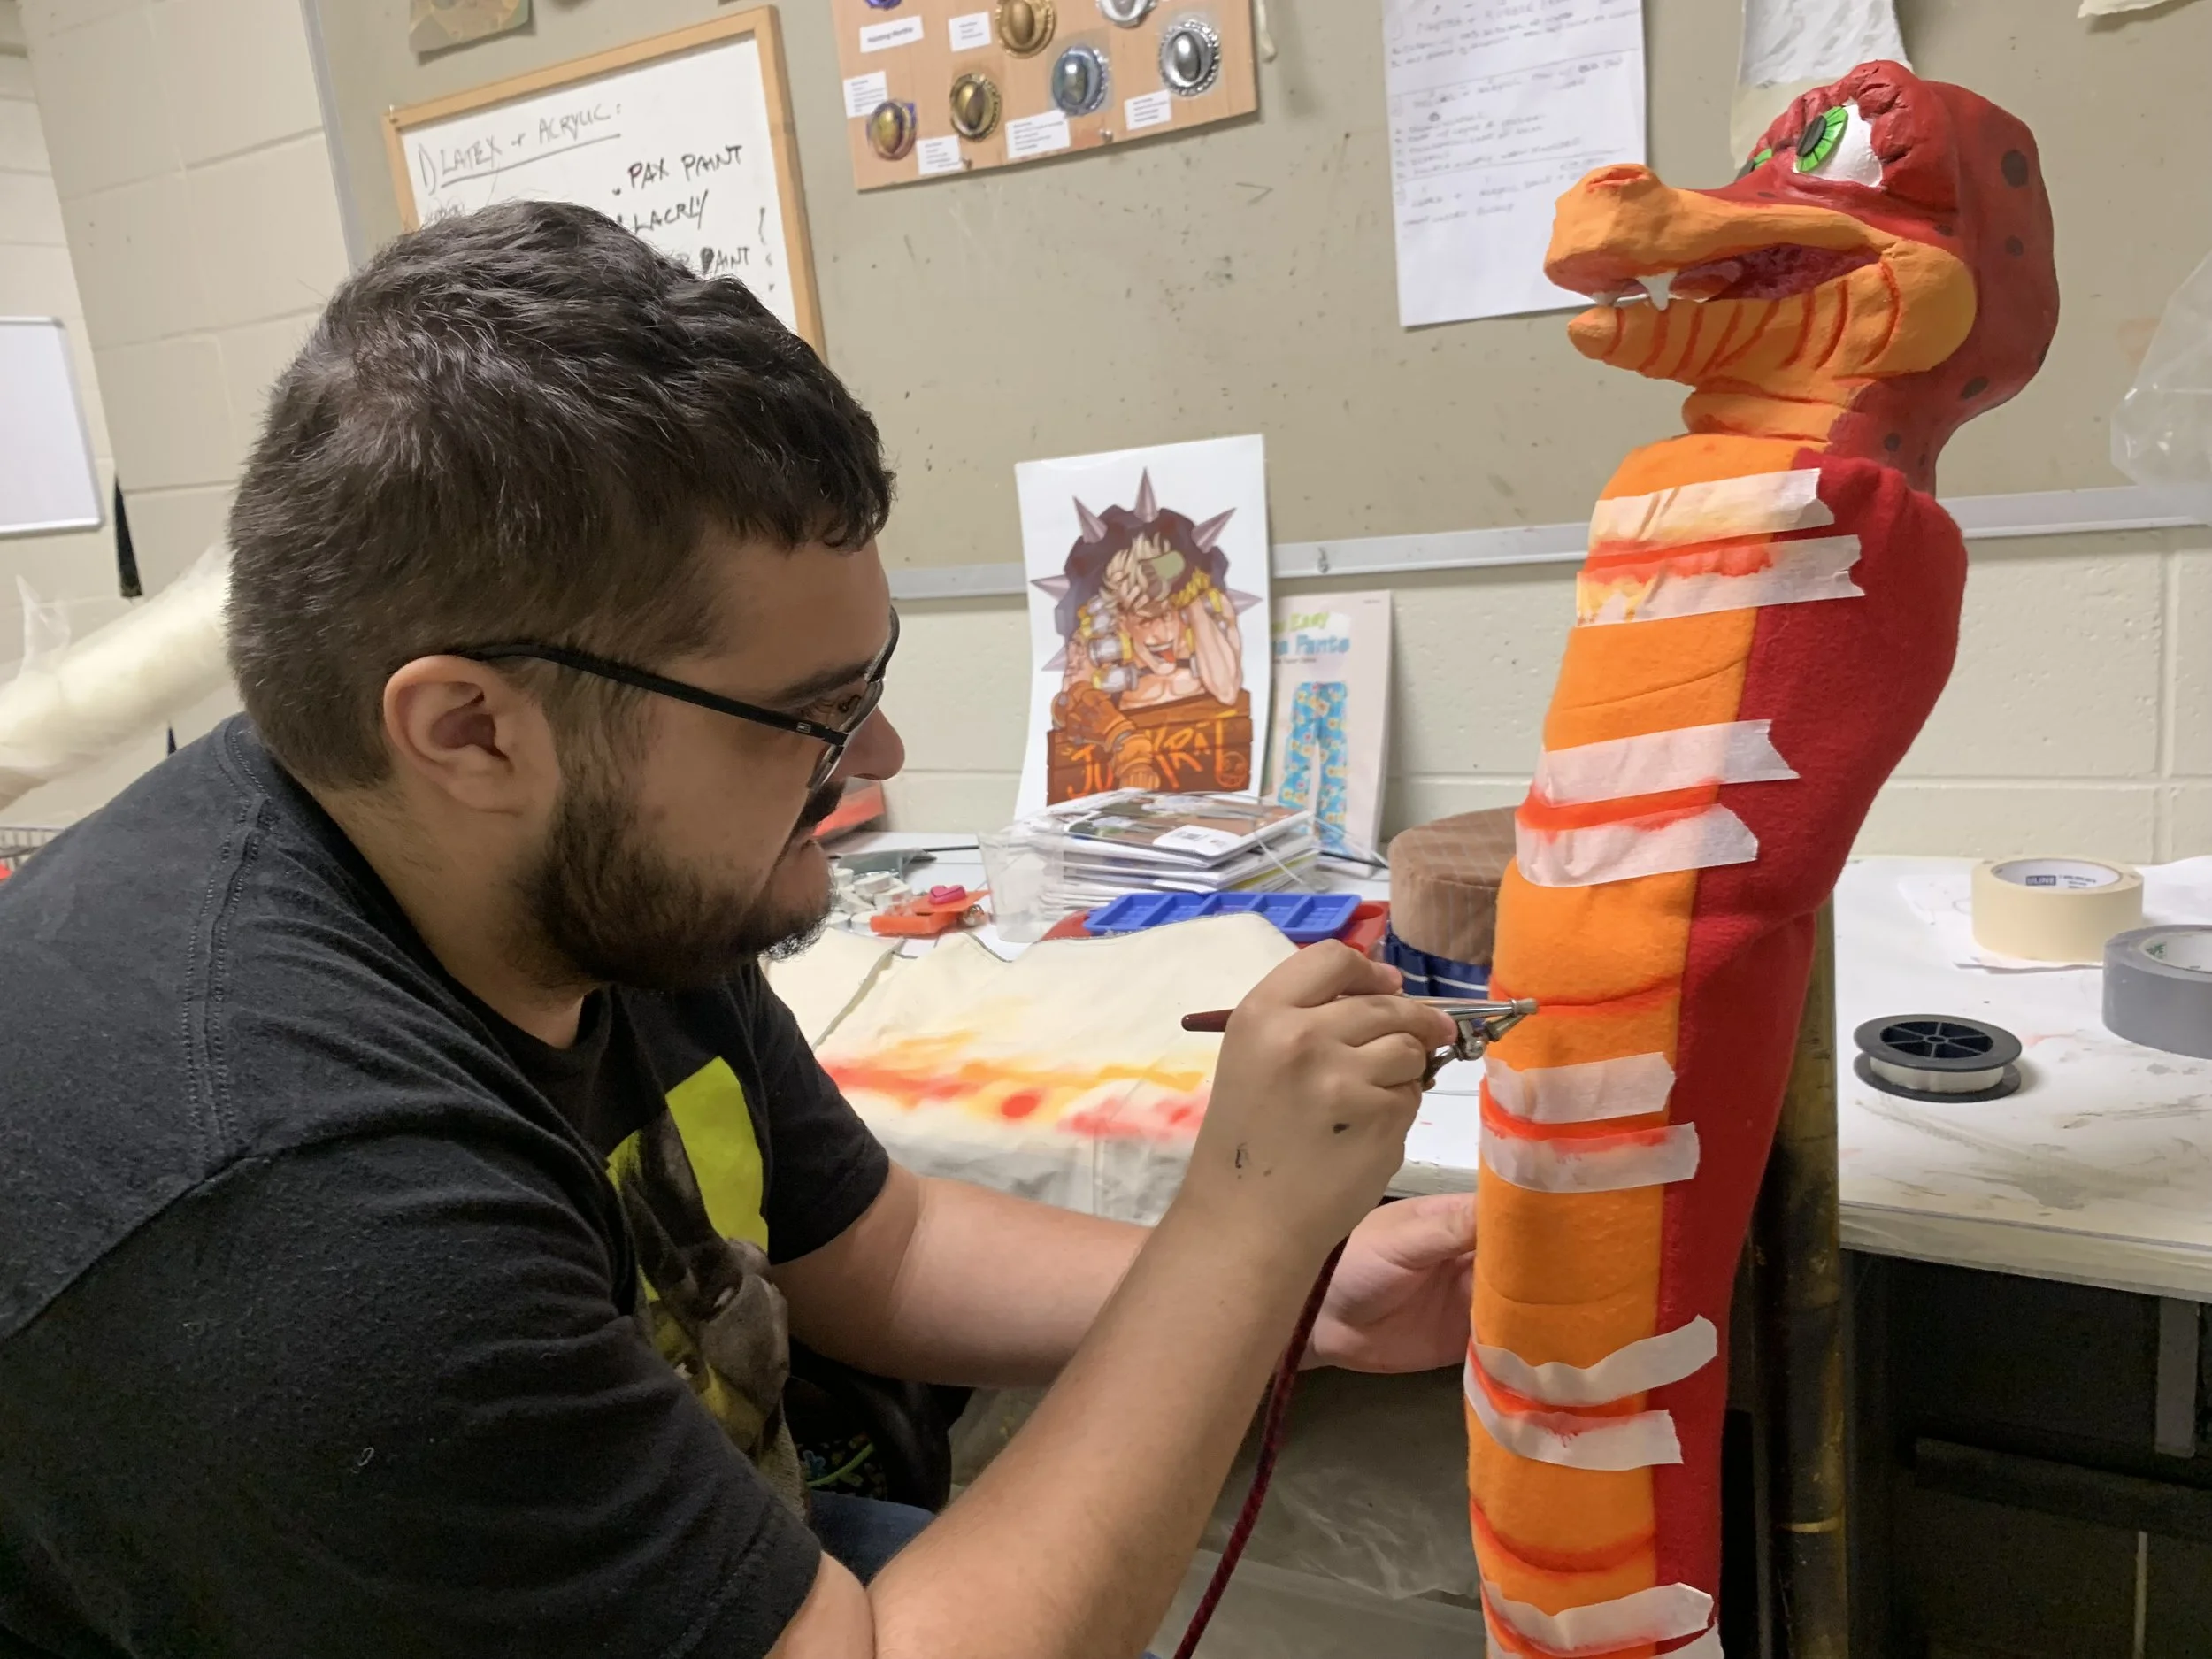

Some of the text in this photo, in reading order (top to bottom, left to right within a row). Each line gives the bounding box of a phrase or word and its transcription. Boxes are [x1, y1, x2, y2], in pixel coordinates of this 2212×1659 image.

[440, 134, 503, 175] LATEX
[627, 144, 743, 189] PAX PAINT
[700, 246, 750, 277] PAINT
[1295, 633, 1350, 655] Pants
[1067, 710, 1238, 799] JUKRAT
